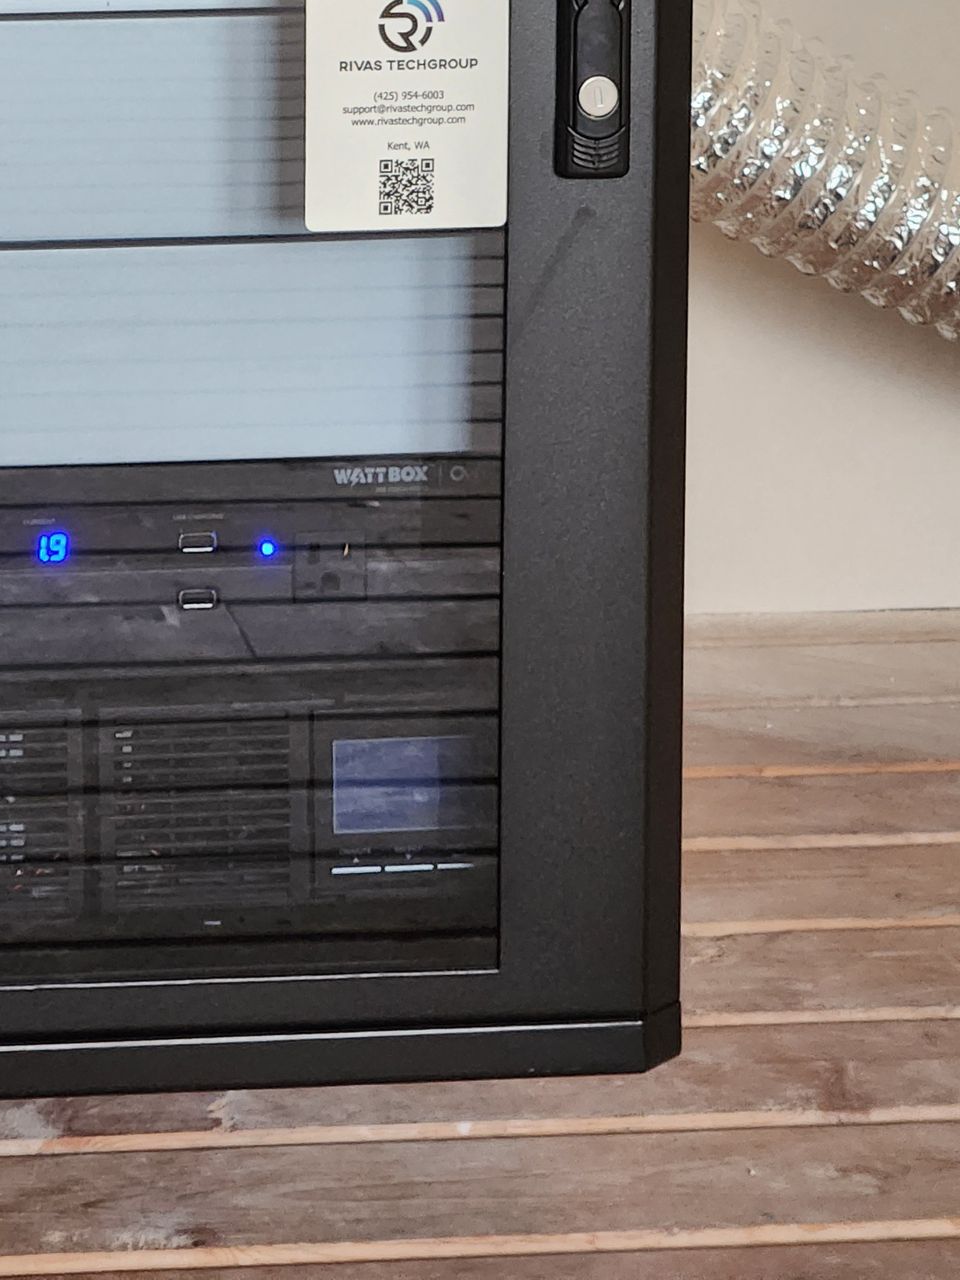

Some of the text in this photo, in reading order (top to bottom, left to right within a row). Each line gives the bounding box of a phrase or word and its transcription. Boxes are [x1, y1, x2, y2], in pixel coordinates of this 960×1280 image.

[339, 58, 479, 72] RIVAS TECHGROUP
[373, 90, 445, 102] (425) 954-6003
[342, 102, 475, 116] support@rivastechgroup.com
[351, 114, 466, 127] www.rivastechgroup.com
[387, 141, 430, 152] Kent, WA
[333, 465, 429, 487] WATTBOX
